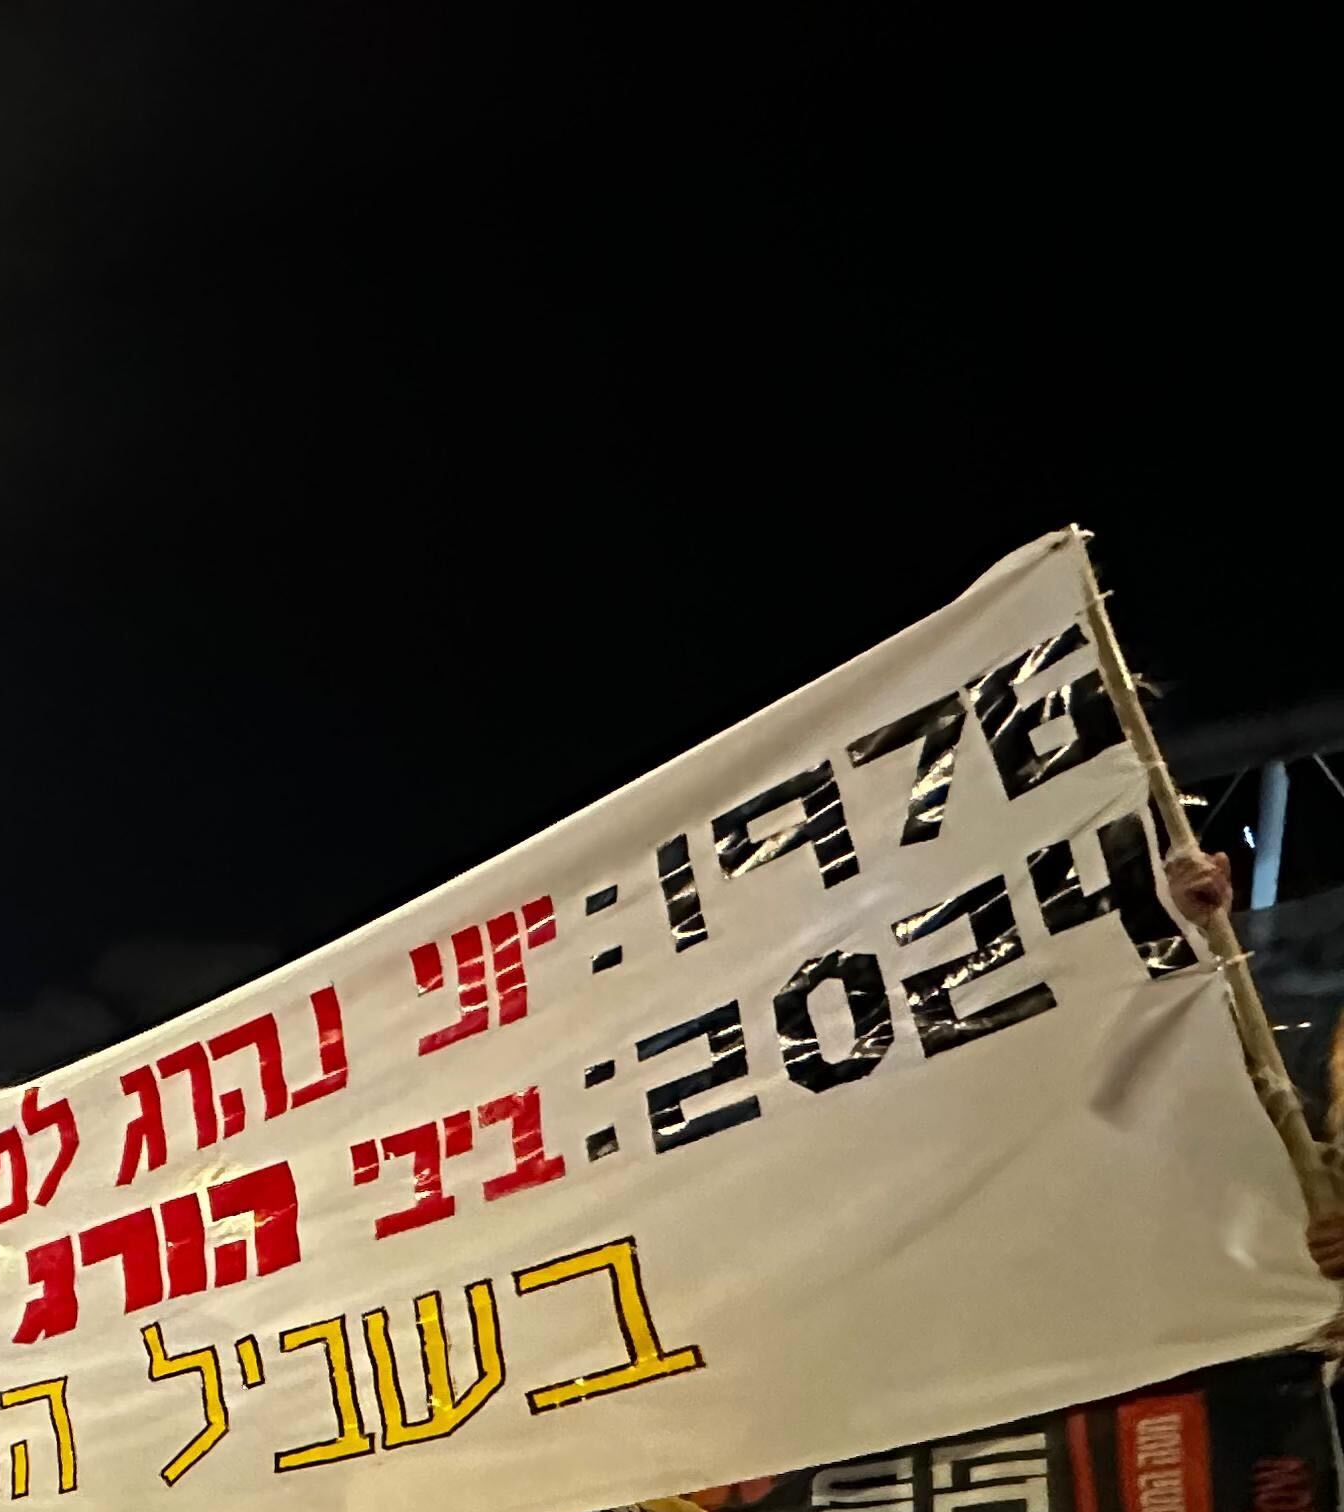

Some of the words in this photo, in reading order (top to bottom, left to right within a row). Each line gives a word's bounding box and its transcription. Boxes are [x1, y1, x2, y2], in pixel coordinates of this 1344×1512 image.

[409, 893, 557, 1057] יוני
[115, 980, 350, 1188] נהרג
[349, 1085, 566, 1240] ביבי
[11, 1160, 302, 1346] הורג
[141, 1235, 707, 1488] בשביל
